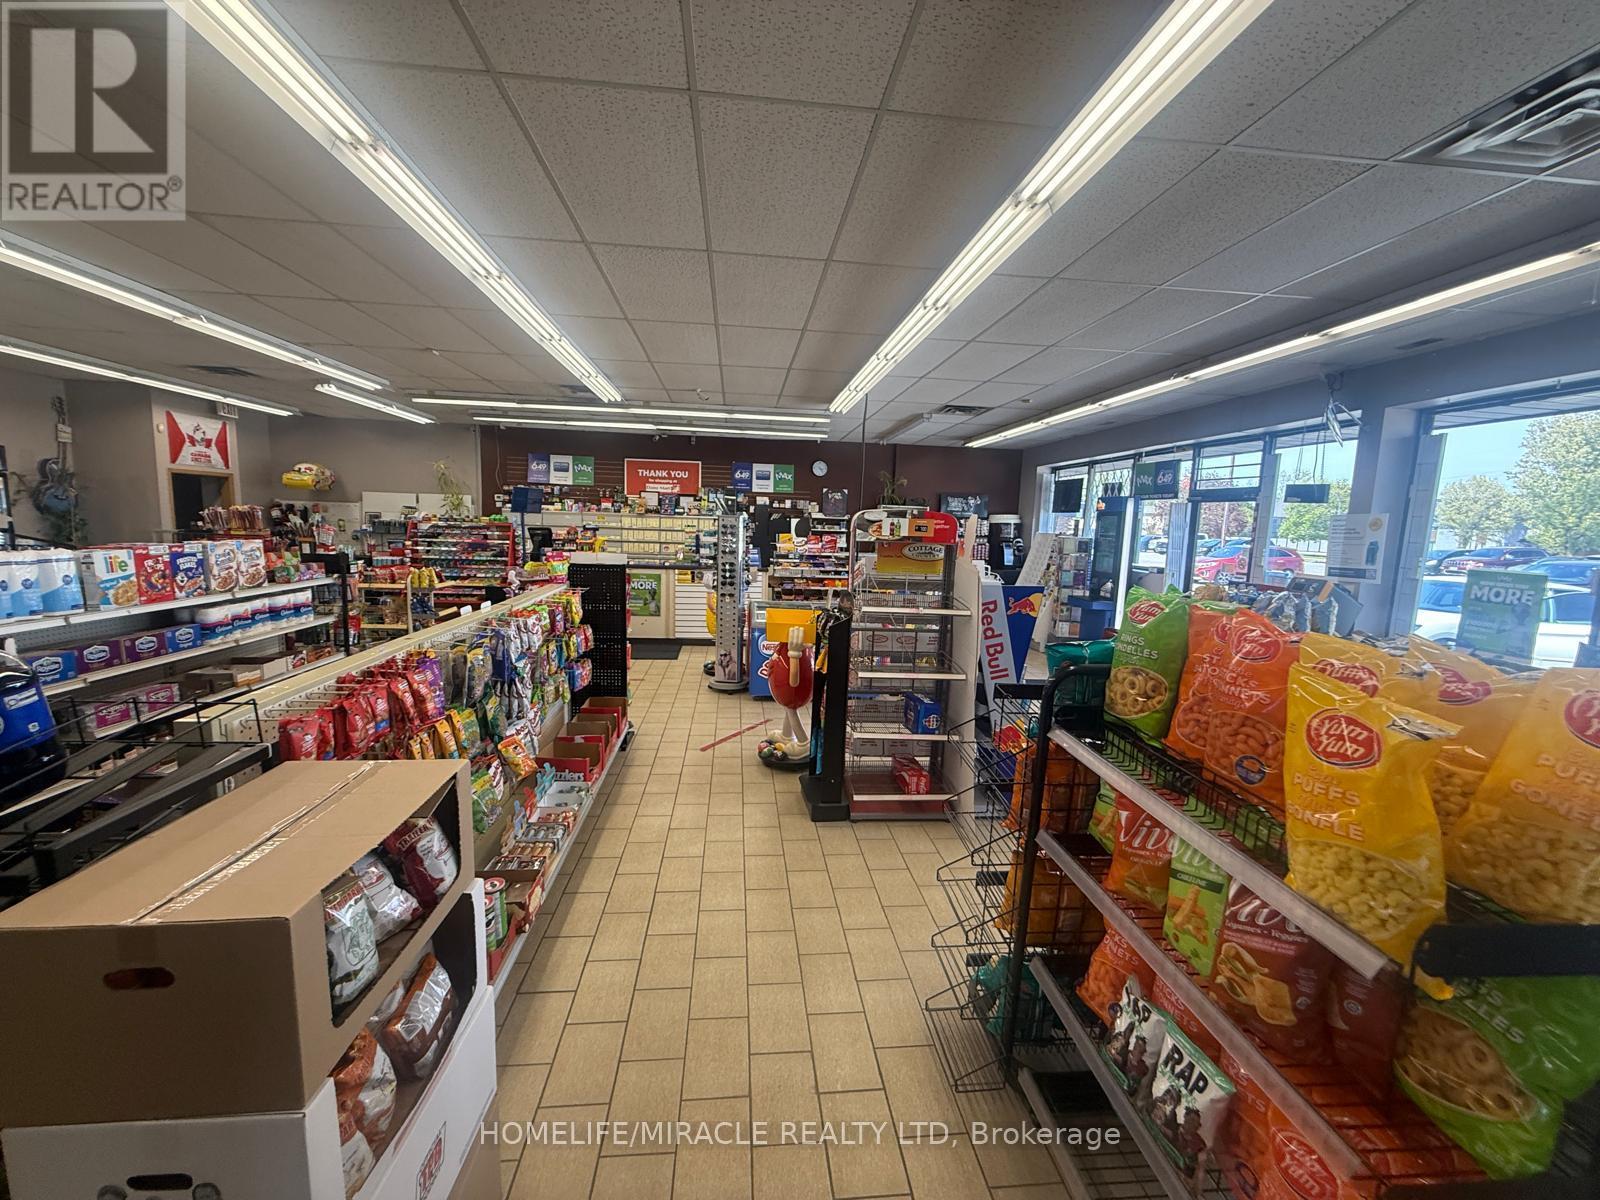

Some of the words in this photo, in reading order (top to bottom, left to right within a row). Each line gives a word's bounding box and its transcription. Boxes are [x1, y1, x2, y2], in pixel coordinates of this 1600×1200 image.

[637, 469, 668, 478] THANK
[670, 470, 689, 478] YOU
[908, 545, 943, 553] COTTAGE
[104, 554, 129, 574] life
[630, 581, 658, 590] MORE
[1469, 584, 1536, 606] MORE
[981, 599, 1003, 641] Red
[985, 642, 1009, 681] Bull
[1319, 718, 1369, 741] Yum
[1318, 735, 1366, 759] Yum
[1293, 772, 1361, 807] PUFFS
